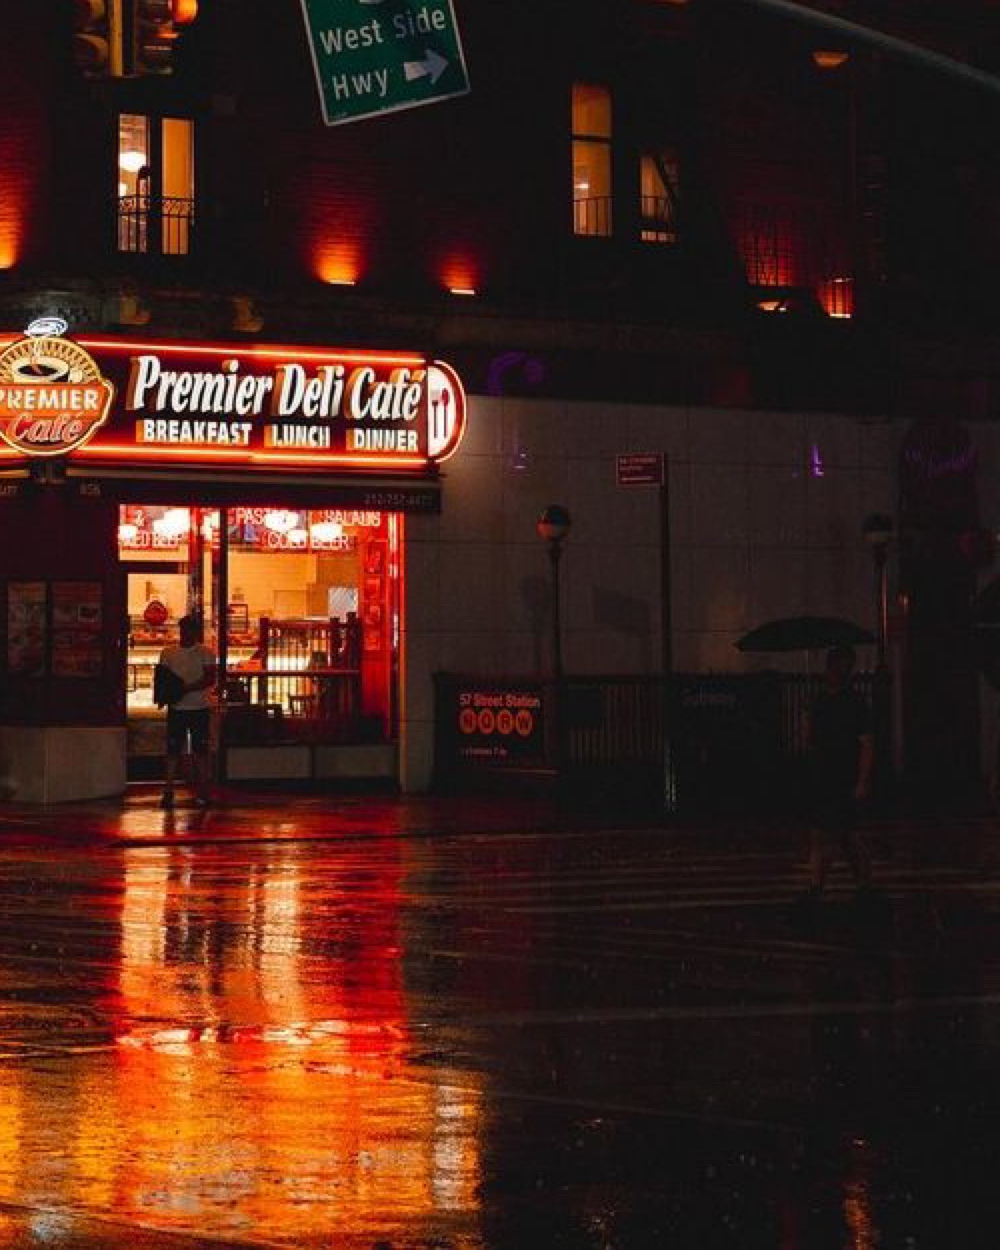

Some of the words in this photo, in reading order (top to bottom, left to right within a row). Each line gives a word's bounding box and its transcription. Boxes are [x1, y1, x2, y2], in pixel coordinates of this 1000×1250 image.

[319, 19, 384, 55] West
[393, 6, 446, 39] Side
[332, 68, 388, 101] Hwy
[133, 356, 273, 417] Premier
[277, 363, 345, 418] Deli
[351, 366, 426, 422] Café
[6, 412, 85, 443] Café
[142, 419, 252, 447] BREAKFAST
[269, 423, 331, 449] LUNCH
[352, 427, 419, 453] DINNER
[505, 692, 541, 707] Station
